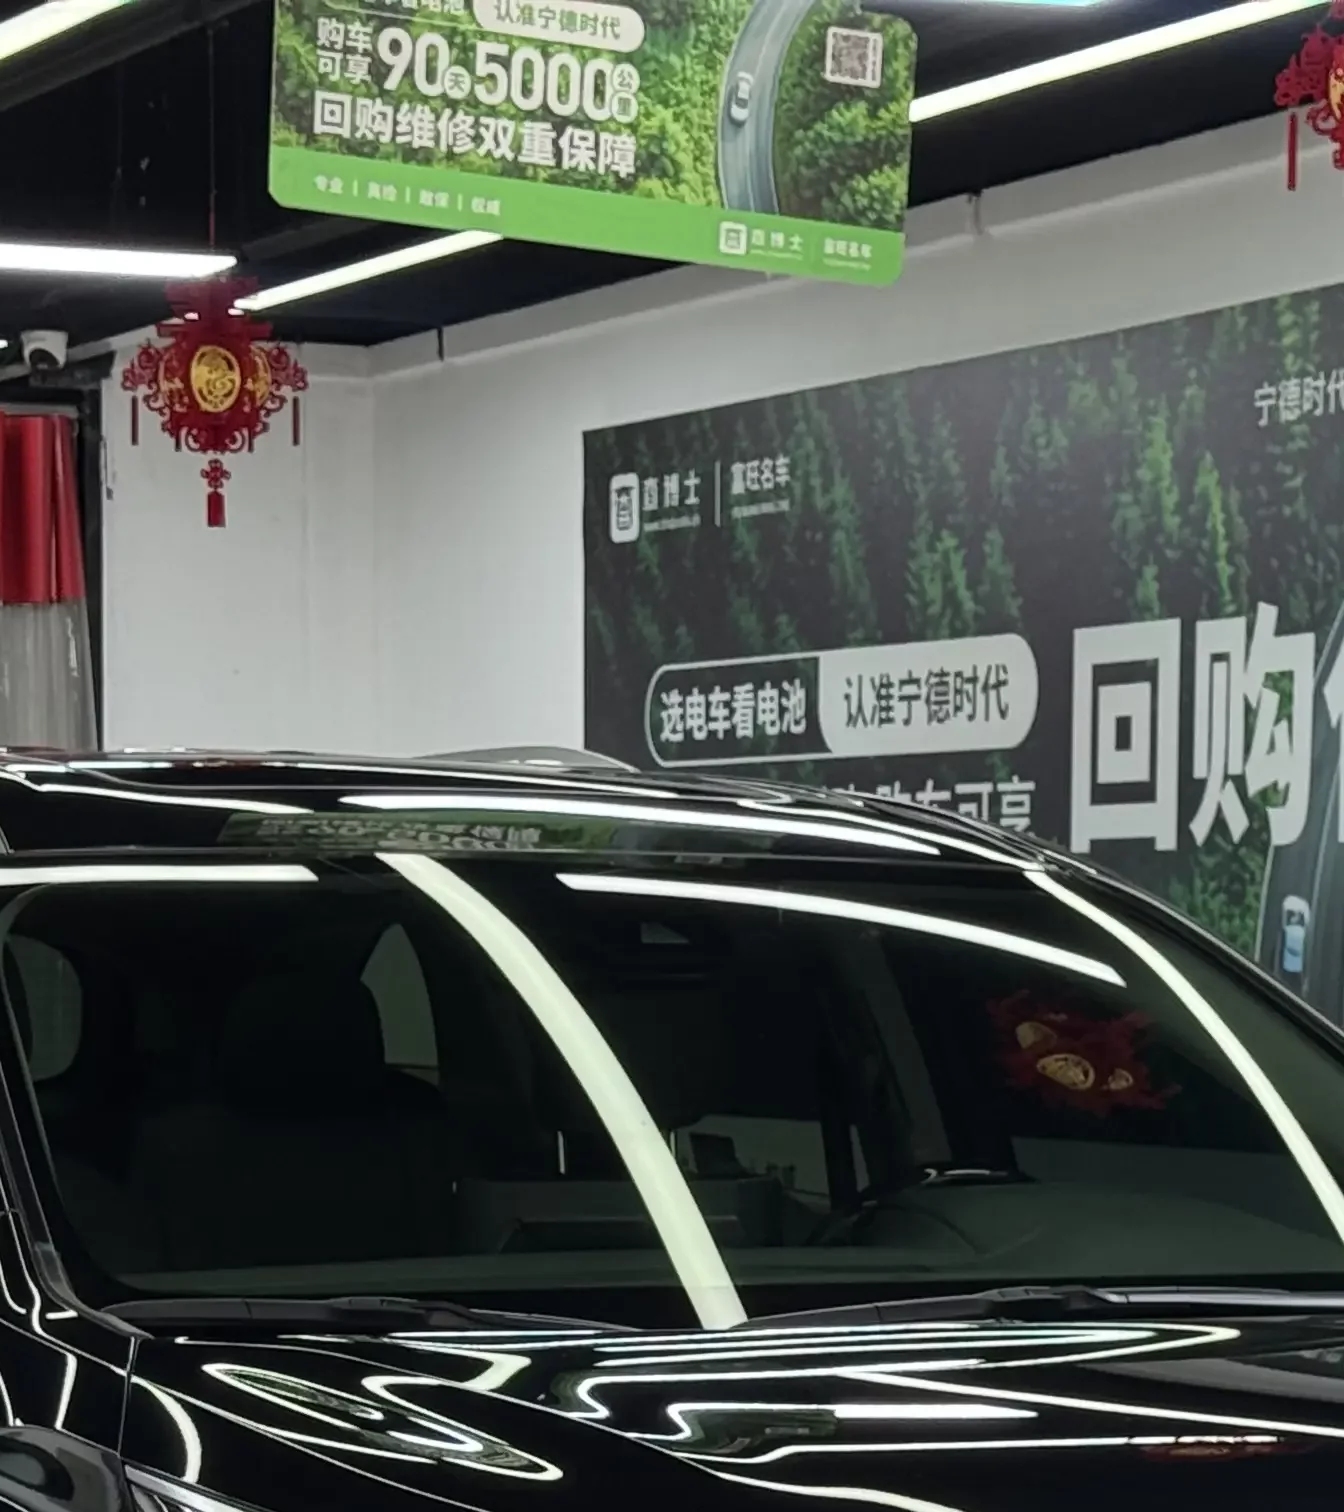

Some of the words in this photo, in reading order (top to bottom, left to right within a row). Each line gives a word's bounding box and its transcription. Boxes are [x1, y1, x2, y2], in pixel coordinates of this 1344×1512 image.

[494, 0, 621, 41] 认准宁德时代
[312, 91, 638, 179] 回购维修双重保障
[659, 676, 808, 743] 选电车看电池
[843, 662, 1010, 730] 认准宁德时代
